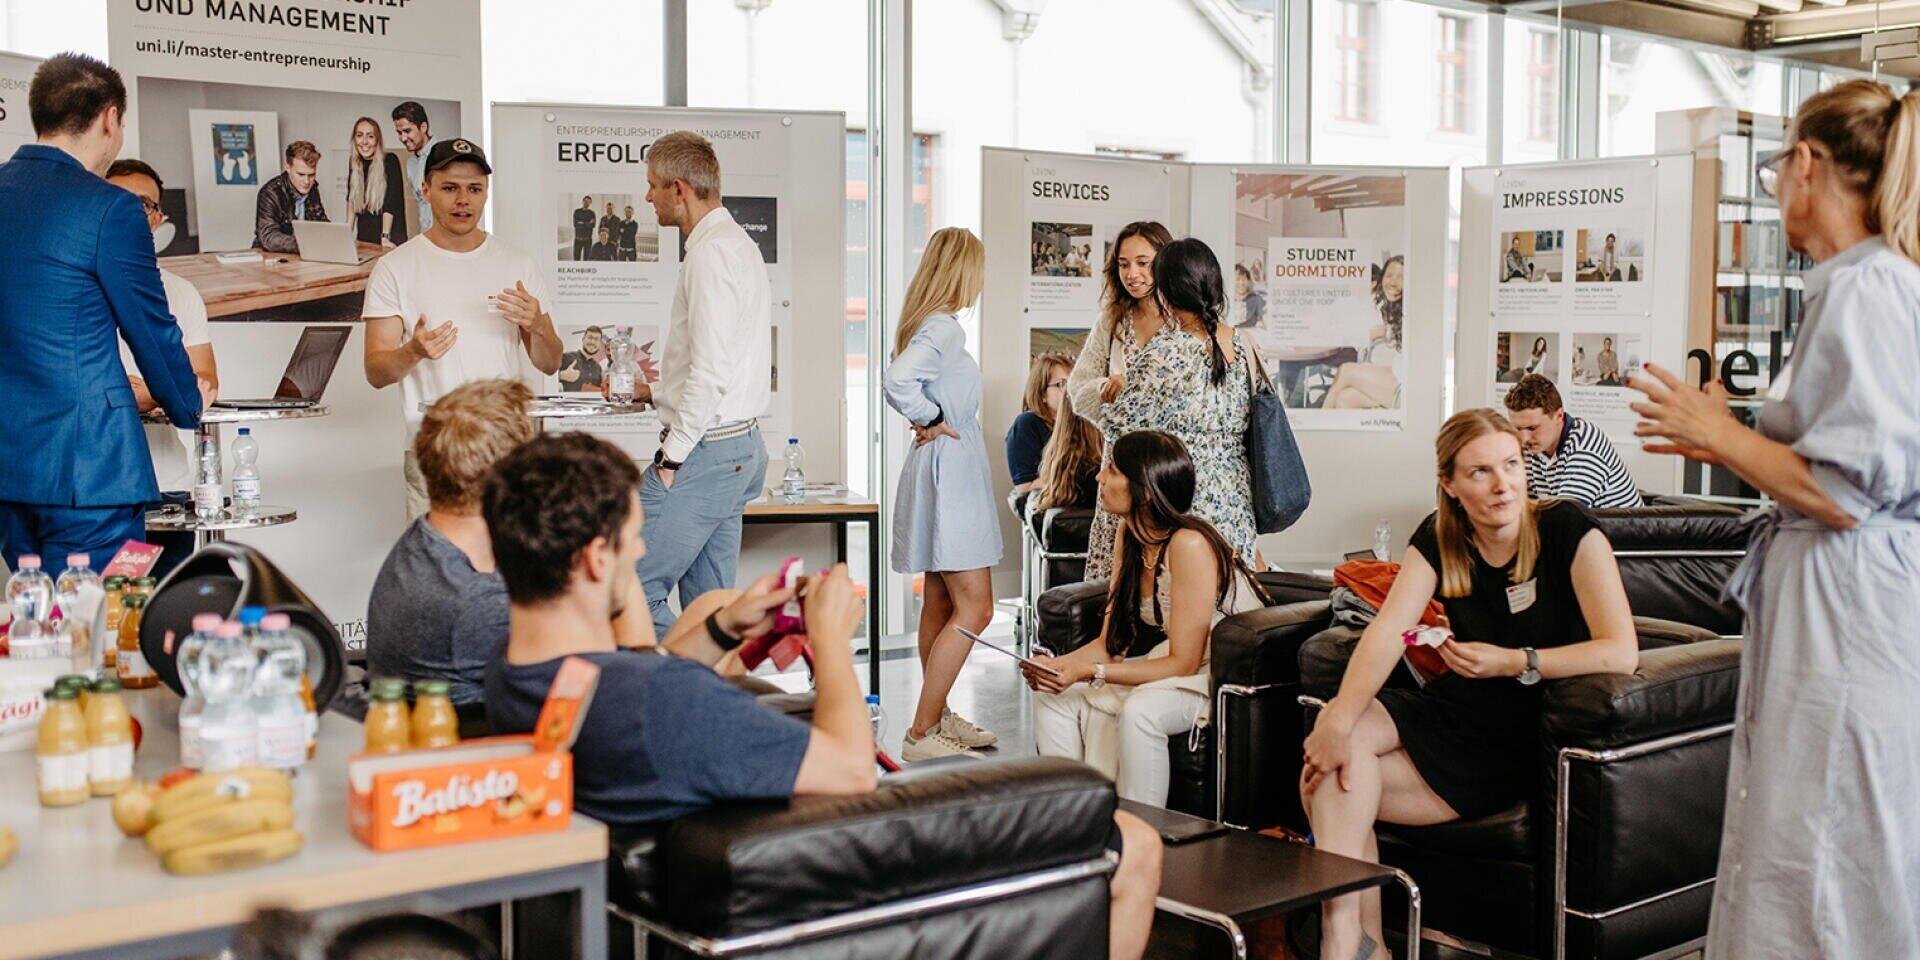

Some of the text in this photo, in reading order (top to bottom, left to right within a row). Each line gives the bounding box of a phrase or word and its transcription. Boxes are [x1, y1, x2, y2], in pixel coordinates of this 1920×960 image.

[136, 0, 391, 36] UND MANAGEMENT
[136, 39, 371, 74] uni.li/master-entrepreneurship
[556, 124, 662, 138] ENTREPRENEURSHIP
[696, 128, 761, 140] ANAGEMENT
[1032, 180, 1110, 201] SERVICES
[1502, 187, 1625, 209] IMPRESSIONS
[1287, 248, 1356, 261] STUDENT
[1275, 264, 1366, 278] DORMITORY
[391, 769, 519, 828] Balisto
